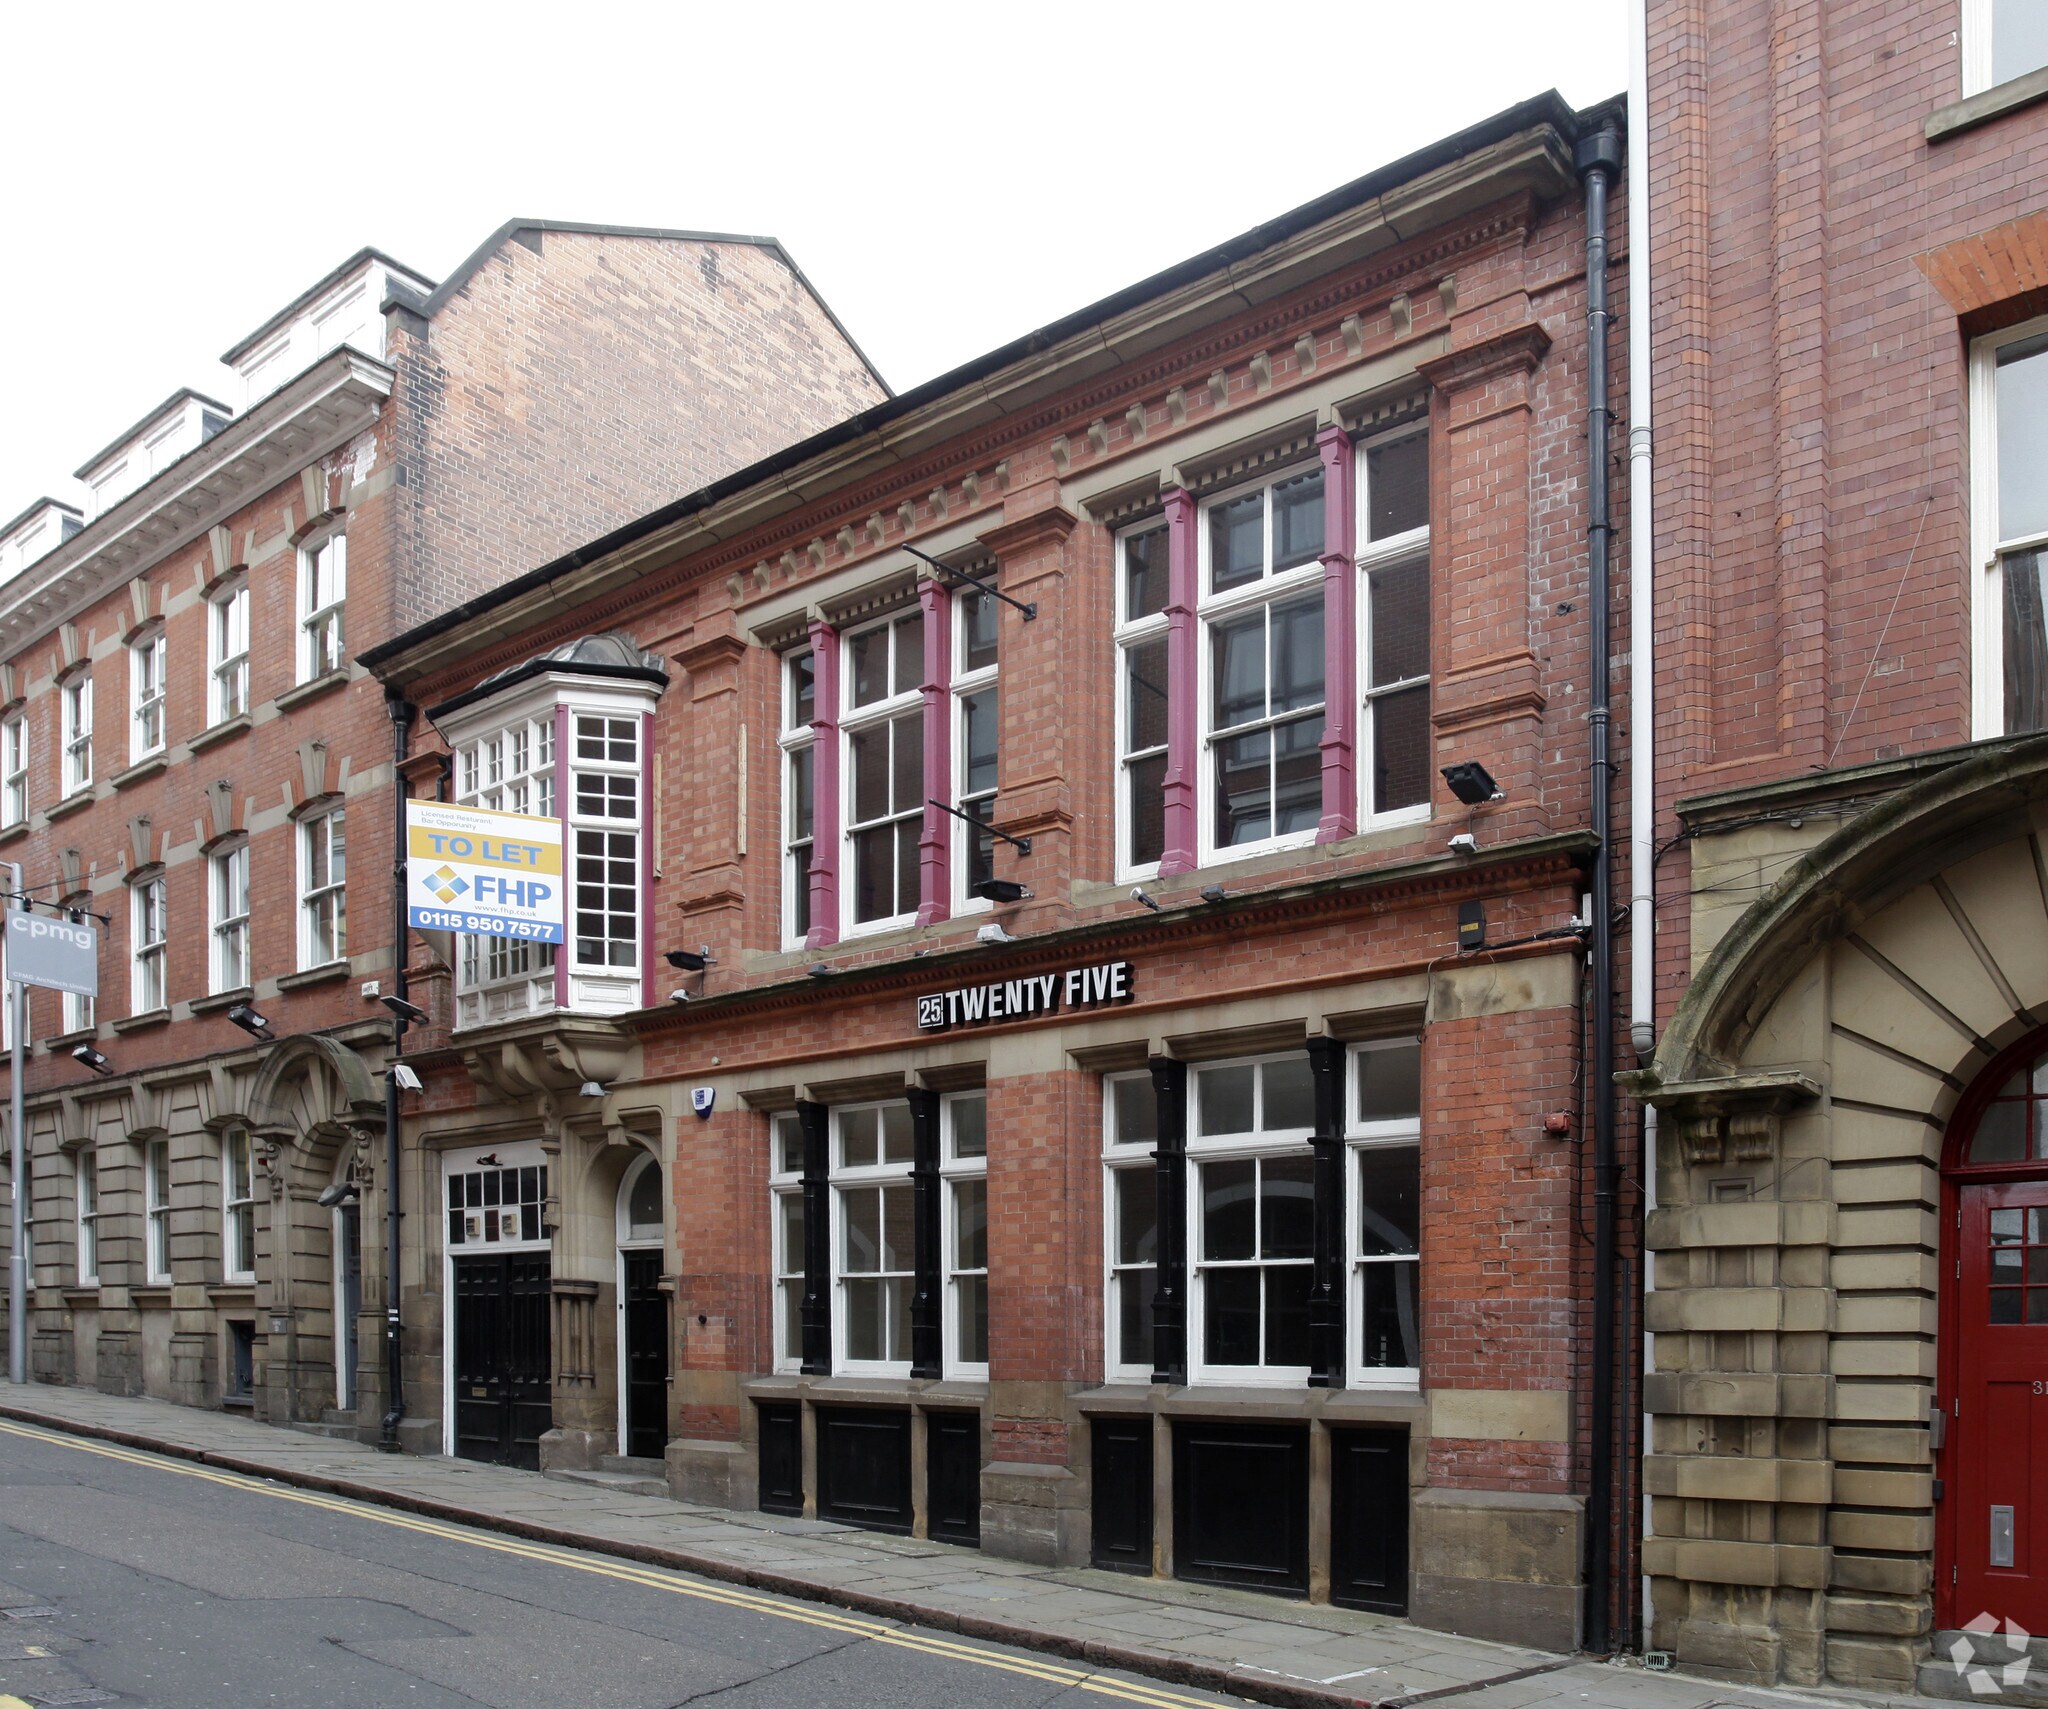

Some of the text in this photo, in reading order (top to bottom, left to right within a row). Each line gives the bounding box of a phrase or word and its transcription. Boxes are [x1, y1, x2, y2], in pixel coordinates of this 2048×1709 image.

[421, 810, 454, 820] Licensed
[421, 817, 434, 825] Bar
[428, 833, 543, 865] TO LET
[474, 875, 552, 909] FHP
[419, 911, 554, 939] 0115 950 7577
[474, 904, 537, 918] www.fhp.co.uk
[12, 917, 92, 949] cpmg
[920, 961, 1127, 1024] 25 TWENTY FIVE
